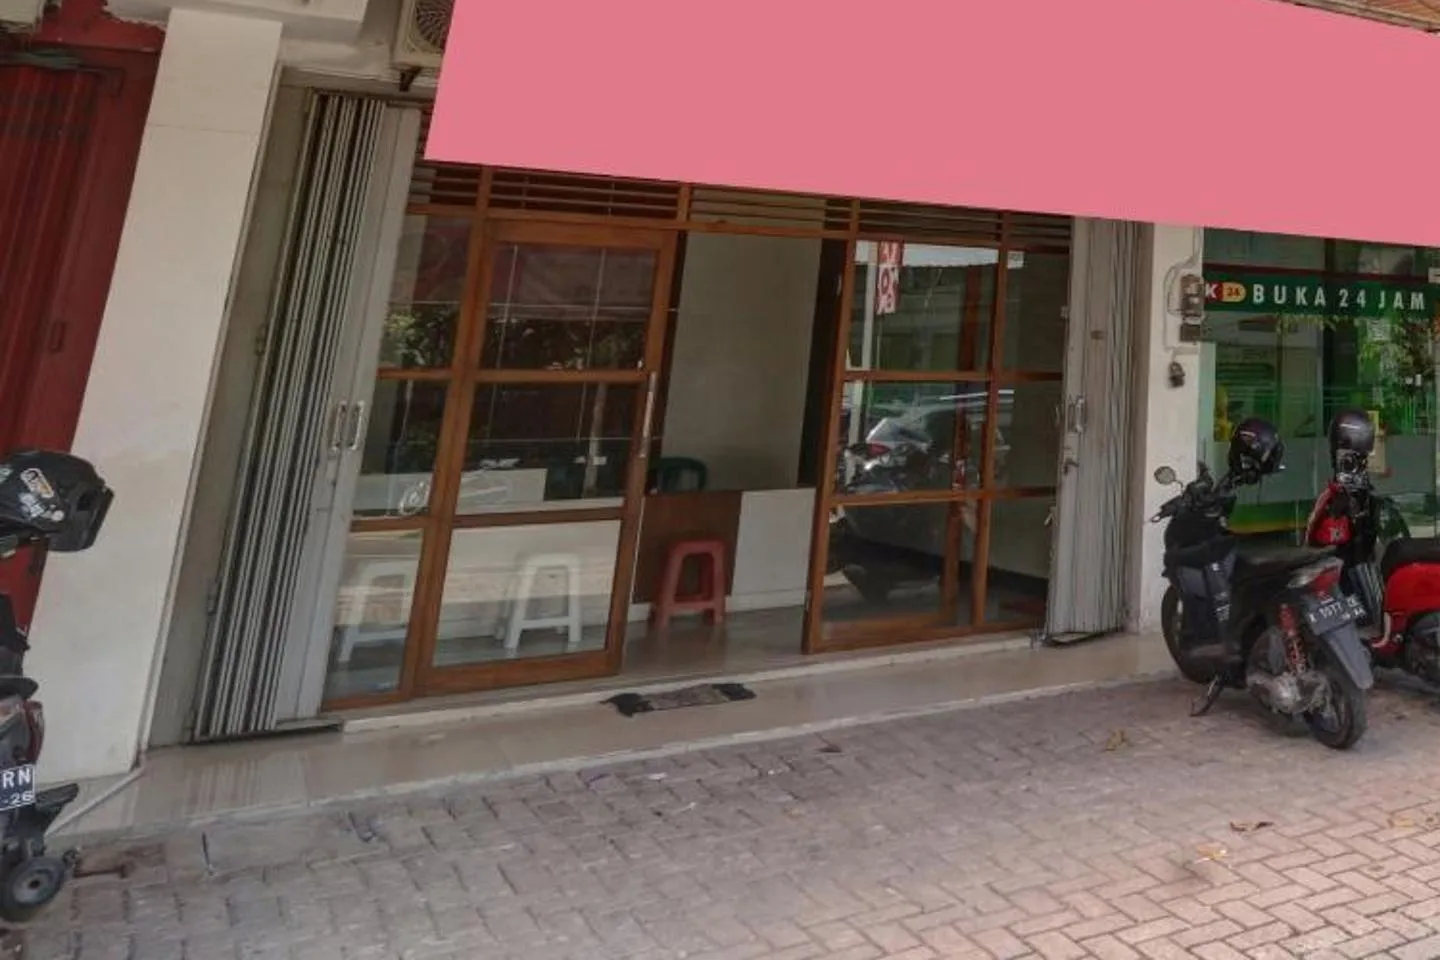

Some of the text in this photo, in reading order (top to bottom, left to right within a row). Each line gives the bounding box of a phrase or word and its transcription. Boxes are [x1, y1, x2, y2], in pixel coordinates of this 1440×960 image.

[1252, 283, 1327, 308] BUKA
[1338, 288, 1367, 308] 24
[1377, 290, 1425, 311] JAM
